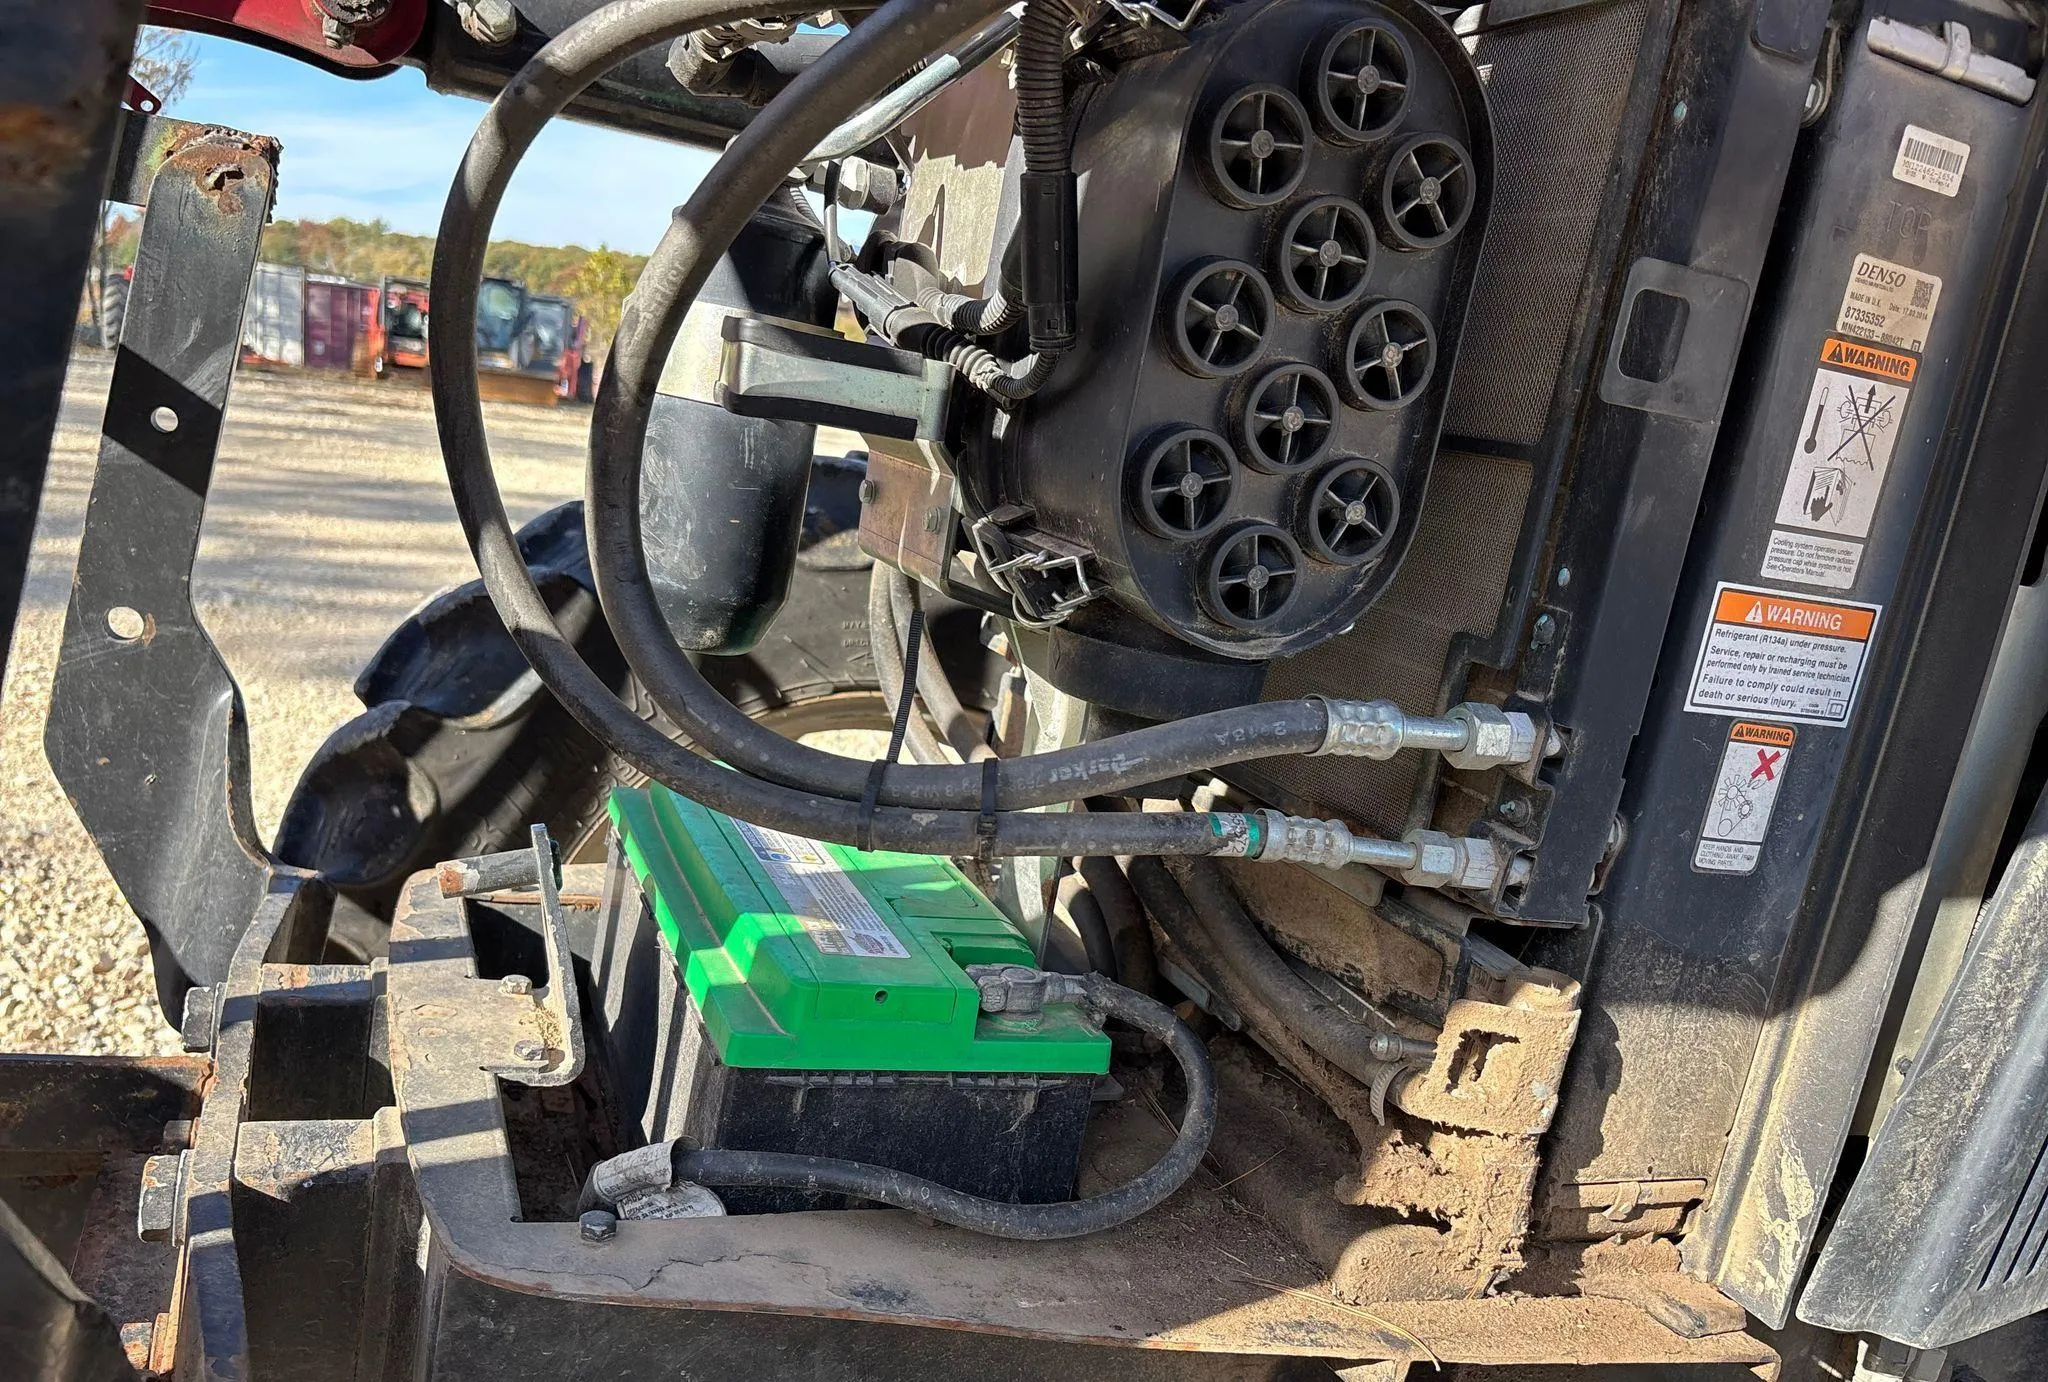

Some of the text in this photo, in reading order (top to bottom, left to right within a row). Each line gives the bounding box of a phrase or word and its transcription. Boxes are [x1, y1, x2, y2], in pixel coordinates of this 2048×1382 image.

[1887, 200, 1932, 241] TOP
[1857, 261, 1907, 288] DENSO
[1849, 291, 1864, 302] MADE
[1864, 295, 1871, 303] IN
[1844, 306, 1886, 328] 87335352
[1845, 347, 1910, 377] WARNING
[1773, 538, 1794, 548] Cooling
[1794, 542, 1813, 551] system
[1814, 545, 1837, 555] operates
[1768, 555, 1791, 564] pressure
[1835, 557, 1854, 565] radiator
[1764, 604, 1844, 630] WARNING
[1714, 628, 1846, 654] Refrigerant (R134a) under pressure.
[1710, 646, 1742, 658] Service,
[1742, 651, 1765, 662] repair
[1776, 654, 1817, 668] recharging
[1818, 660, 1836, 668] must
[1838, 662, 1848, 670] be
[1706, 659, 1852, 683] performed only by trained service technician.
[1703, 673, 1842, 697] Failure to comply could result in
[1698, 689, 1723, 699] death
[1737, 693, 1768, 704] serious
[1770, 697, 1797, 709] injury.
[1745, 728, 1790, 742] WARNING
[1700, 850, 1724, 858] CLOTHING
[1716, 844, 1733, 852] HANDS
